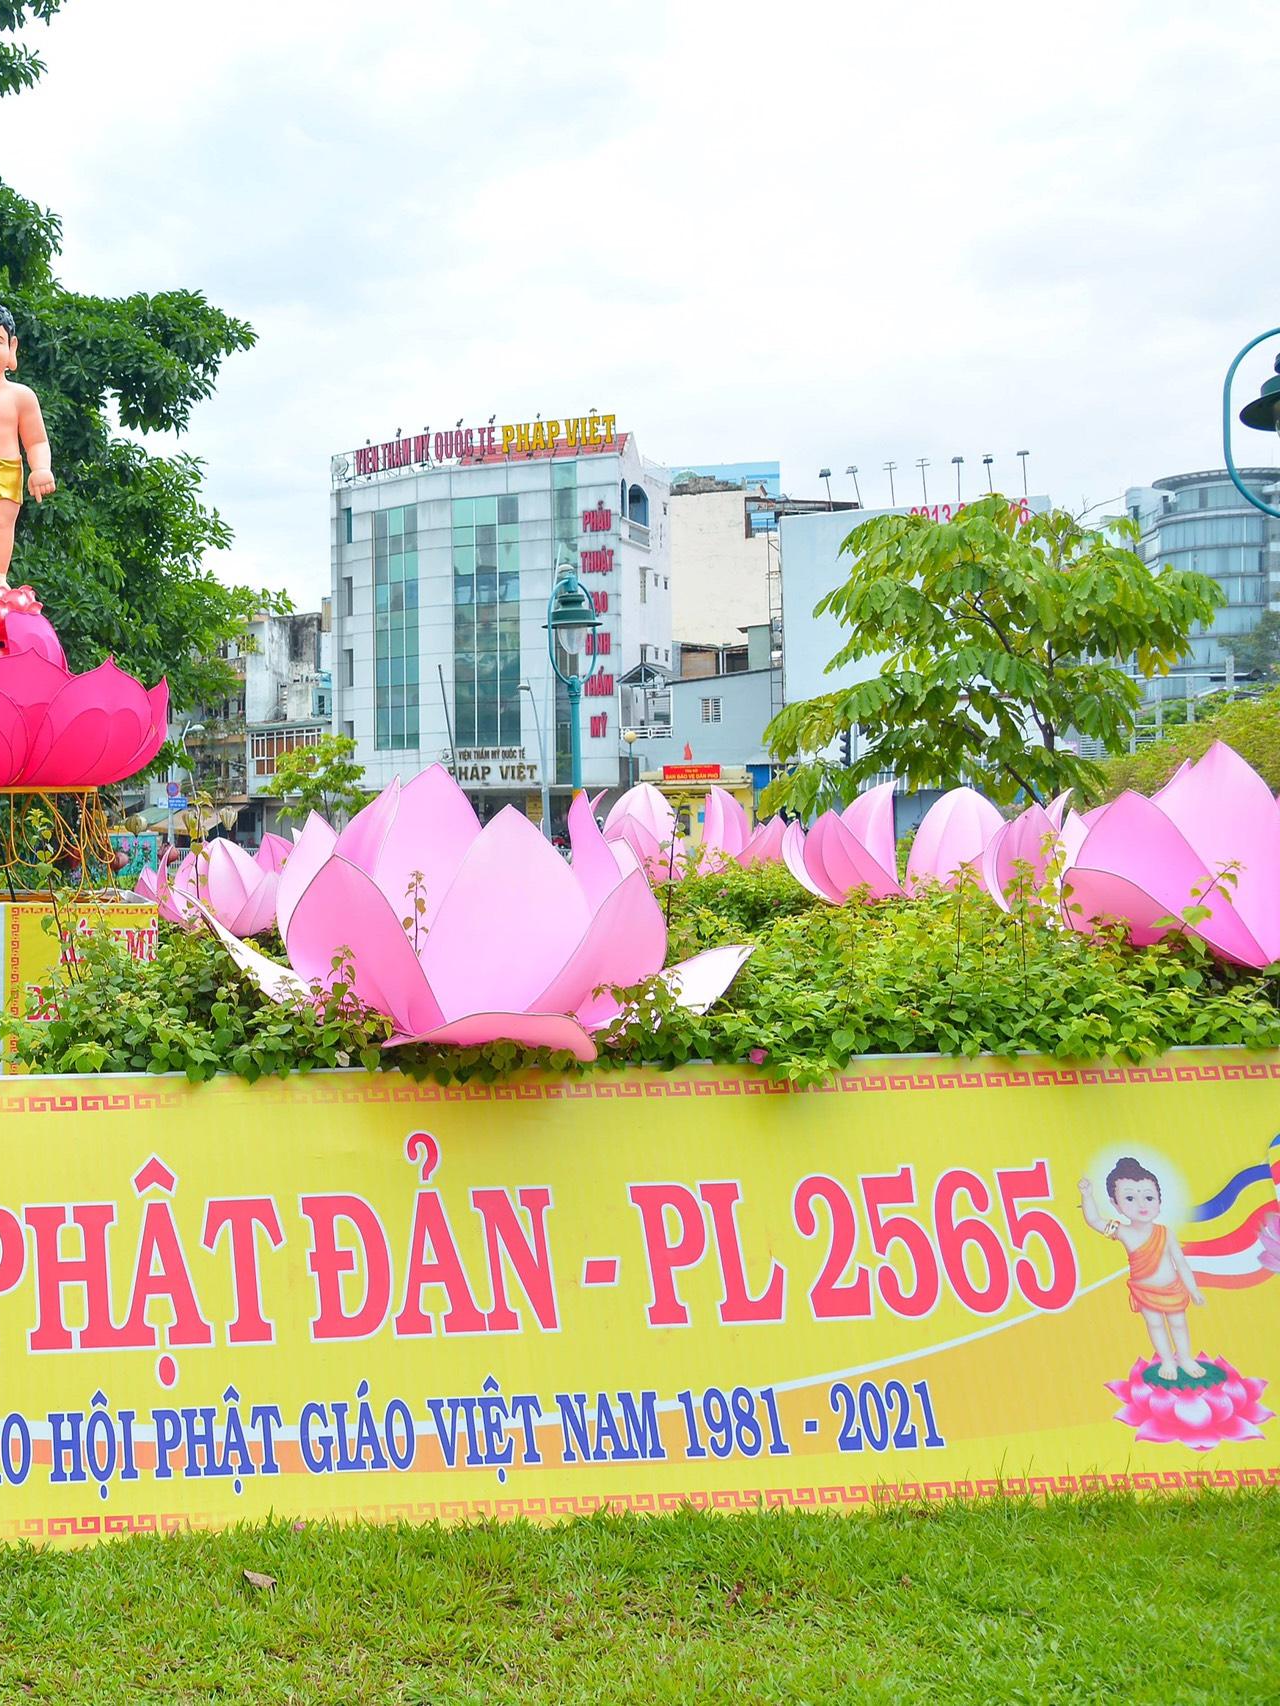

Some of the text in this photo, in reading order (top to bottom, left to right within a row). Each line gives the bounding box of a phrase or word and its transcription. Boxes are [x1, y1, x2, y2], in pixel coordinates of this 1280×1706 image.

[580, 545, 614, 576] THUẬT
[584, 632, 611, 656] HNH
[499, 763, 538, 782] VIỆT
[300, 1131, 559, 1340] ĐẢN
[584, 1258, 618, 1286] -
[629, 1182, 785, 1326] PL
[794, 1161, 1078, 1319] 2565
[46, 1389, 139, 1500] HỘI
[150, 1383, 283, 1495] PHẬT
[298, 1378, 416, 1475] GIÁO
[425, 1375, 543, 1484] VIỆT
[554, 1390, 667, 1463] NAM
[676, 1385, 791, 1459] 1981
[804, 1418, 818, 1434] -
[829, 1379, 946, 1453] 2021
